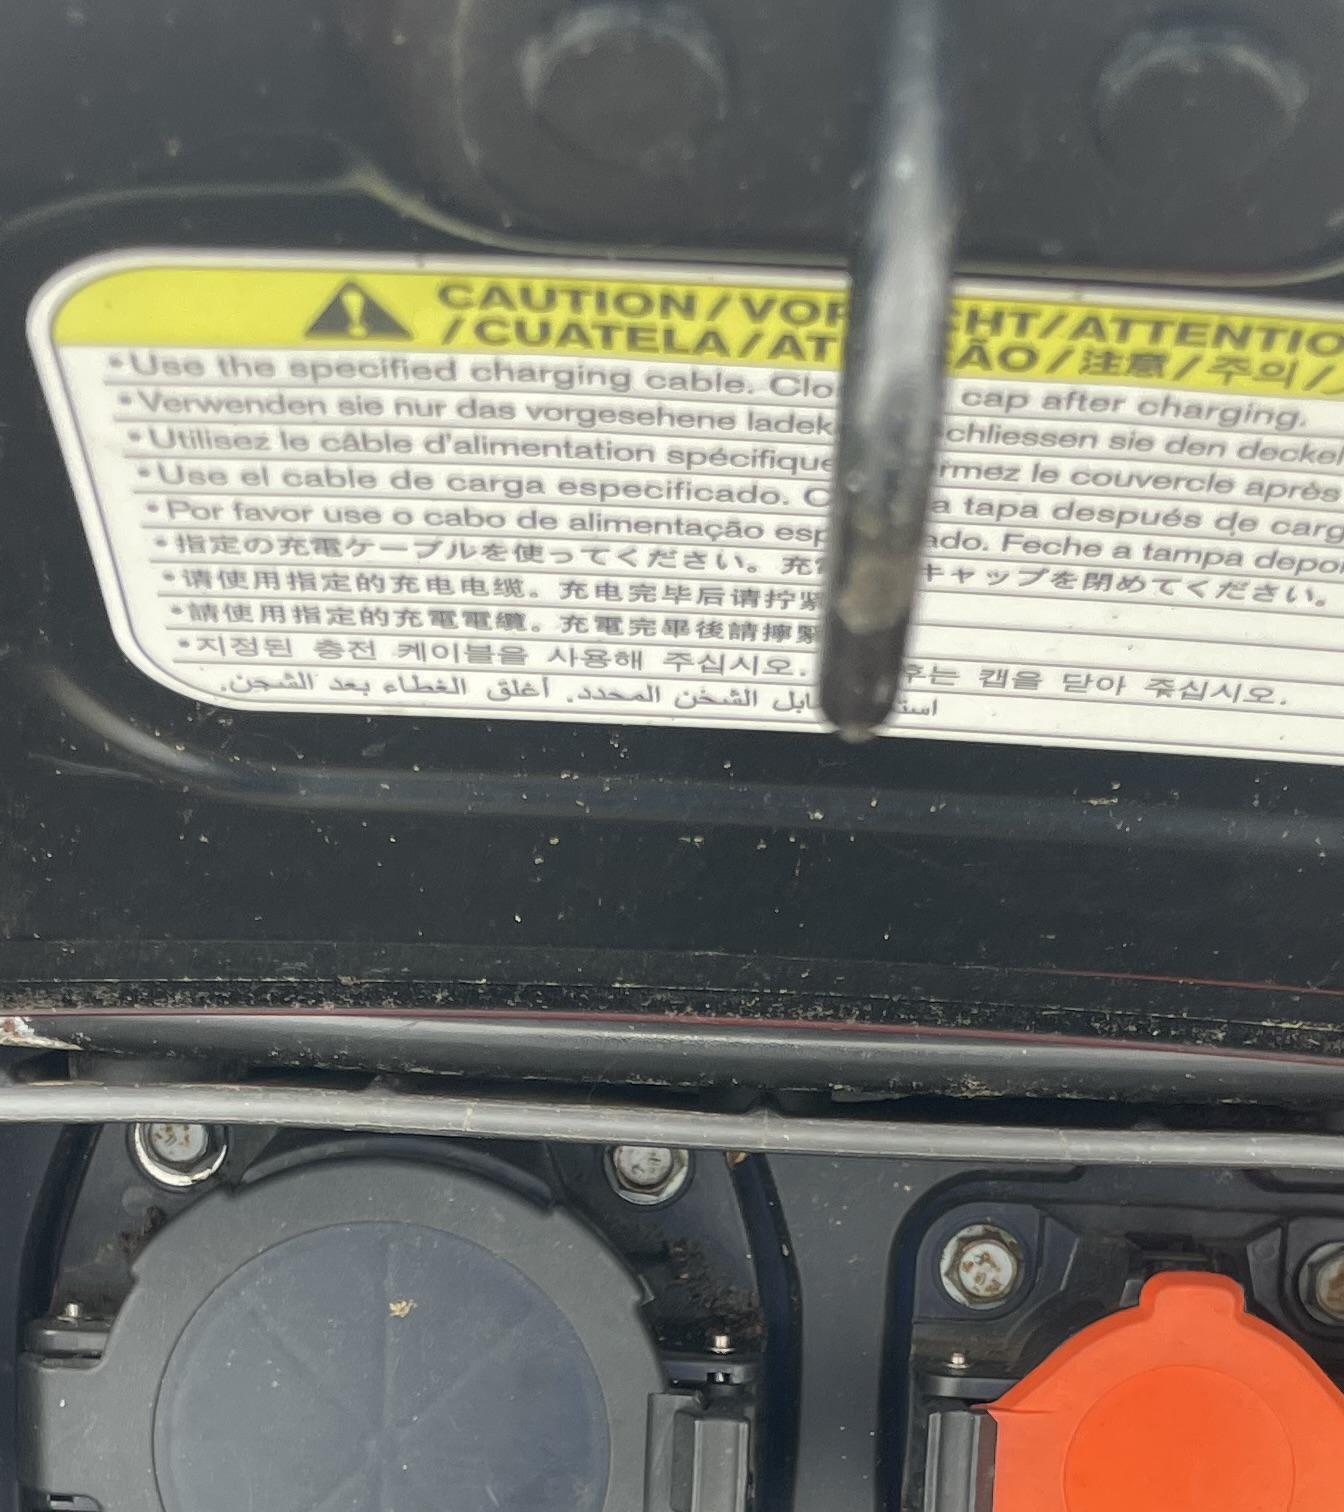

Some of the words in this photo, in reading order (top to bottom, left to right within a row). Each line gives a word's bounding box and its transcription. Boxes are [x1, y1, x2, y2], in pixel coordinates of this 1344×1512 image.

[131, 353, 205, 378] Use
[218, 356, 276, 379] the
[289, 356, 456, 385] specified
[470, 360, 631, 391] charging
[644, 371, 753, 395] cable.
[769, 374, 833, 399] Clo
[961, 389, 1029, 413] cap
[1041, 391, 1126, 412] after
[1137, 395, 1306, 431] charging.
[137, 389, 327, 416] Verwenden
[338, 394, 383, 416] sie
[394, 401, 446, 418] nur
[457, 397, 516, 420] das
[527, 404, 736, 429] vorgesehene
[943, 423, 1097, 449] chliessen
[1108, 431, 1154, 452] sie
[1164, 433, 1226, 457] den
[148, 427, 270, 451] Utilisez
[281, 430, 310, 452] le
[319, 432, 413, 454] câble
[424, 433, 656, 464] d'alimentation
[666, 446, 833, 476] spécifique
[1032, 461, 1060, 485] le
[1070, 468, 1236, 494] couvercle
[1244, 478, 1342, 503] après
[158, 463, 228, 486] Use
[241, 465, 268, 487] el
[282, 466, 378, 489] cable
[390, 469, 434, 492] de
[447, 474, 546, 498] carga
[557, 477, 790, 506] especificado.
[964, 496, 1039, 522] tapa
[1052, 501, 1202, 529] después
[1214, 511, 1258, 533] de
[167, 500, 224, 521] Por
[234, 502, 313, 523] favor
[323, 507, 382, 524] use
[392, 510, 413, 525] o
[424, 508, 506, 529] cabo
[517, 510, 559, 530] de
[569, 513, 765, 542] alimentação
[1002, 533, 1102, 558] Feche
[1111, 543, 1132, 560] a
[1142, 543, 1243, 570] tampa
[196, 636, 294, 660] 지정된
[314, 639, 377, 661] 충전
[397, 641, 529, 666] 케이블을
[547, 646, 643, 671] 사용해
[662, 652, 807, 677] 주십시오.
[978, 667, 1044, 692] 캡을
[1062, 672, 1126, 696] 닫아
[1144, 679, 1288, 706] 주십시오.
[329, 677, 371, 696] بعد
[383, 673, 467, 695] الغطاء
